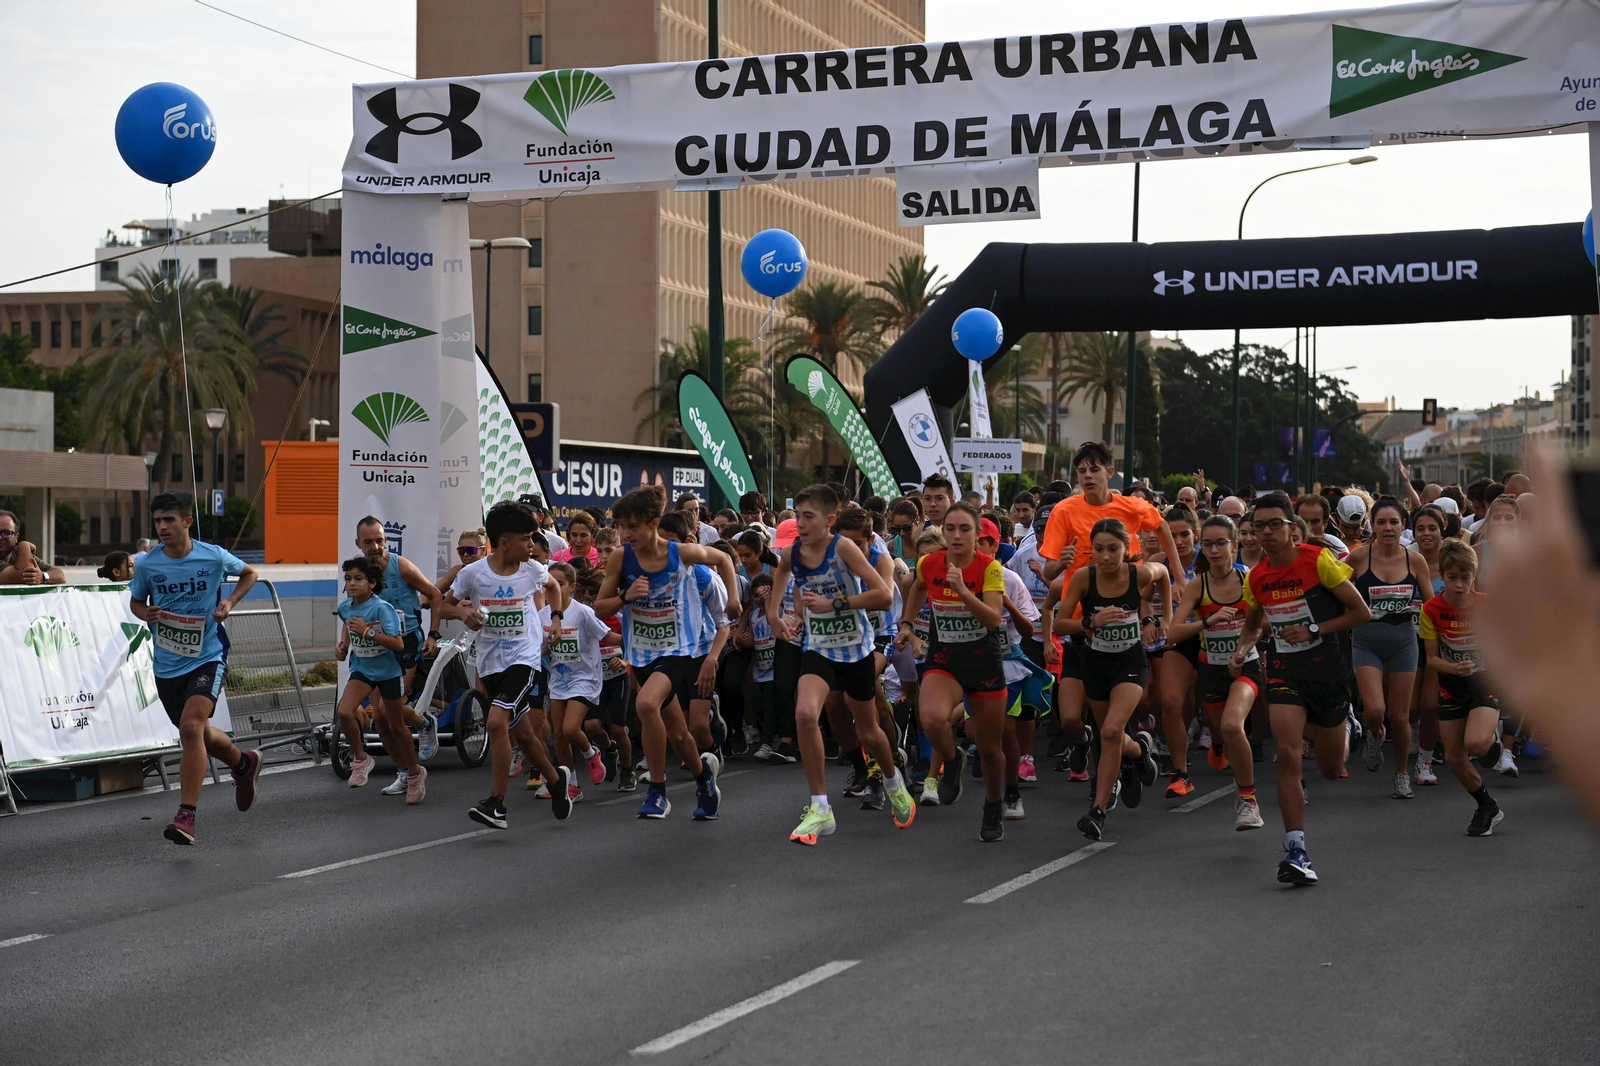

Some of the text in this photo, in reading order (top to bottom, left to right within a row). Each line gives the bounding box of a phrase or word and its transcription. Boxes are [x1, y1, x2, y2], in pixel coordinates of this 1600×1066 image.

[695, 19, 1258, 99] CARRERA URBANA
[1357, 58, 1405, 77] Corte
[1575, 97, 1596, 111] de
[675, 99, 1277, 176] CIUDAD DE MÁLAGA
[526, 138, 613, 158] Fundación
[356, 172, 491, 187] UNDER ARMOUR
[538, 164, 601, 185] Unicaja
[902, 186, 1036, 218] SALIDA
[1204, 260, 1478, 292] UNDER ARMOUR
[356, 324, 381, 335] Corte
[352, 450, 427, 463] Fundación
[363, 469, 415, 486] Unicaja
[552, 460, 622, 497] CESUR
[675, 471, 703, 484] FP DUAL
[215, 493, 223, 512] P
[552, 505, 561, 518] Tu
[156, 577, 208, 595] nerja
[635, 624, 674, 639] 22095
[811, 618, 854, 635] 21423
[940, 619, 981, 631] 21049
[1095, 626, 1135, 641] 20901
[159, 626, 199, 645] 20480
